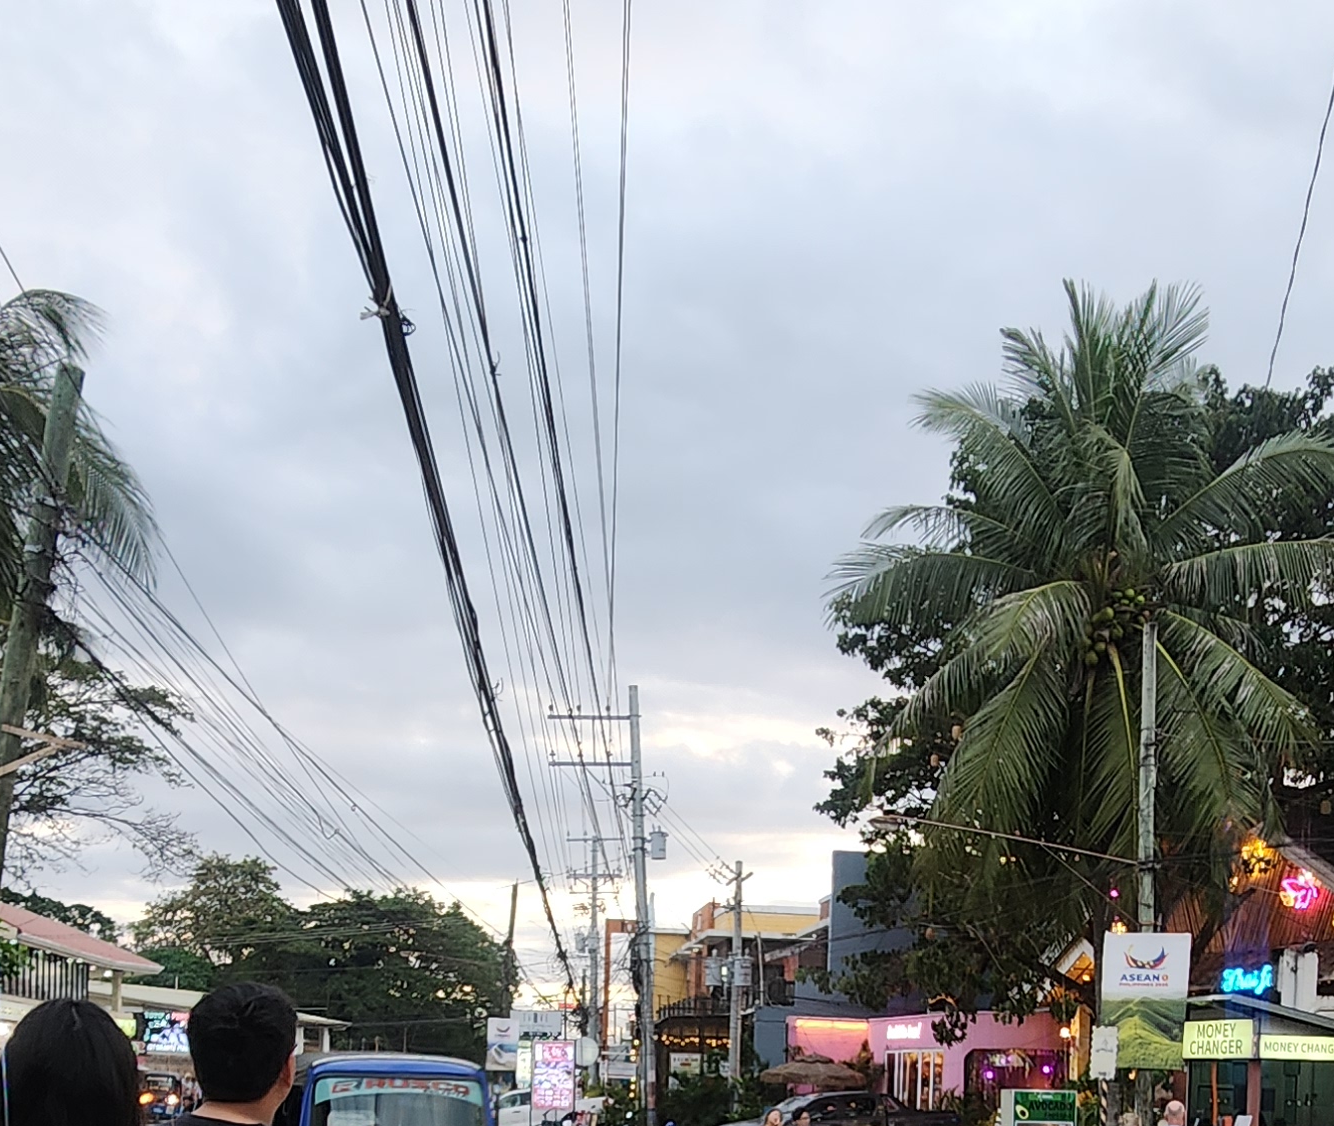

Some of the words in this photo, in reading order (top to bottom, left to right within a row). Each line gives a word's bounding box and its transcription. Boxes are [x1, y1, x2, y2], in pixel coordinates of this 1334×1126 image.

[1120, 973, 1160, 981] ASEAN
[1196, 1022, 1237, 1039] MONEY
[1189, 1040, 1243, 1055] CHANGER
[1264, 1042, 1299, 1053] MONEY
[1029, 1101, 1072, 1110] AVOCADO
